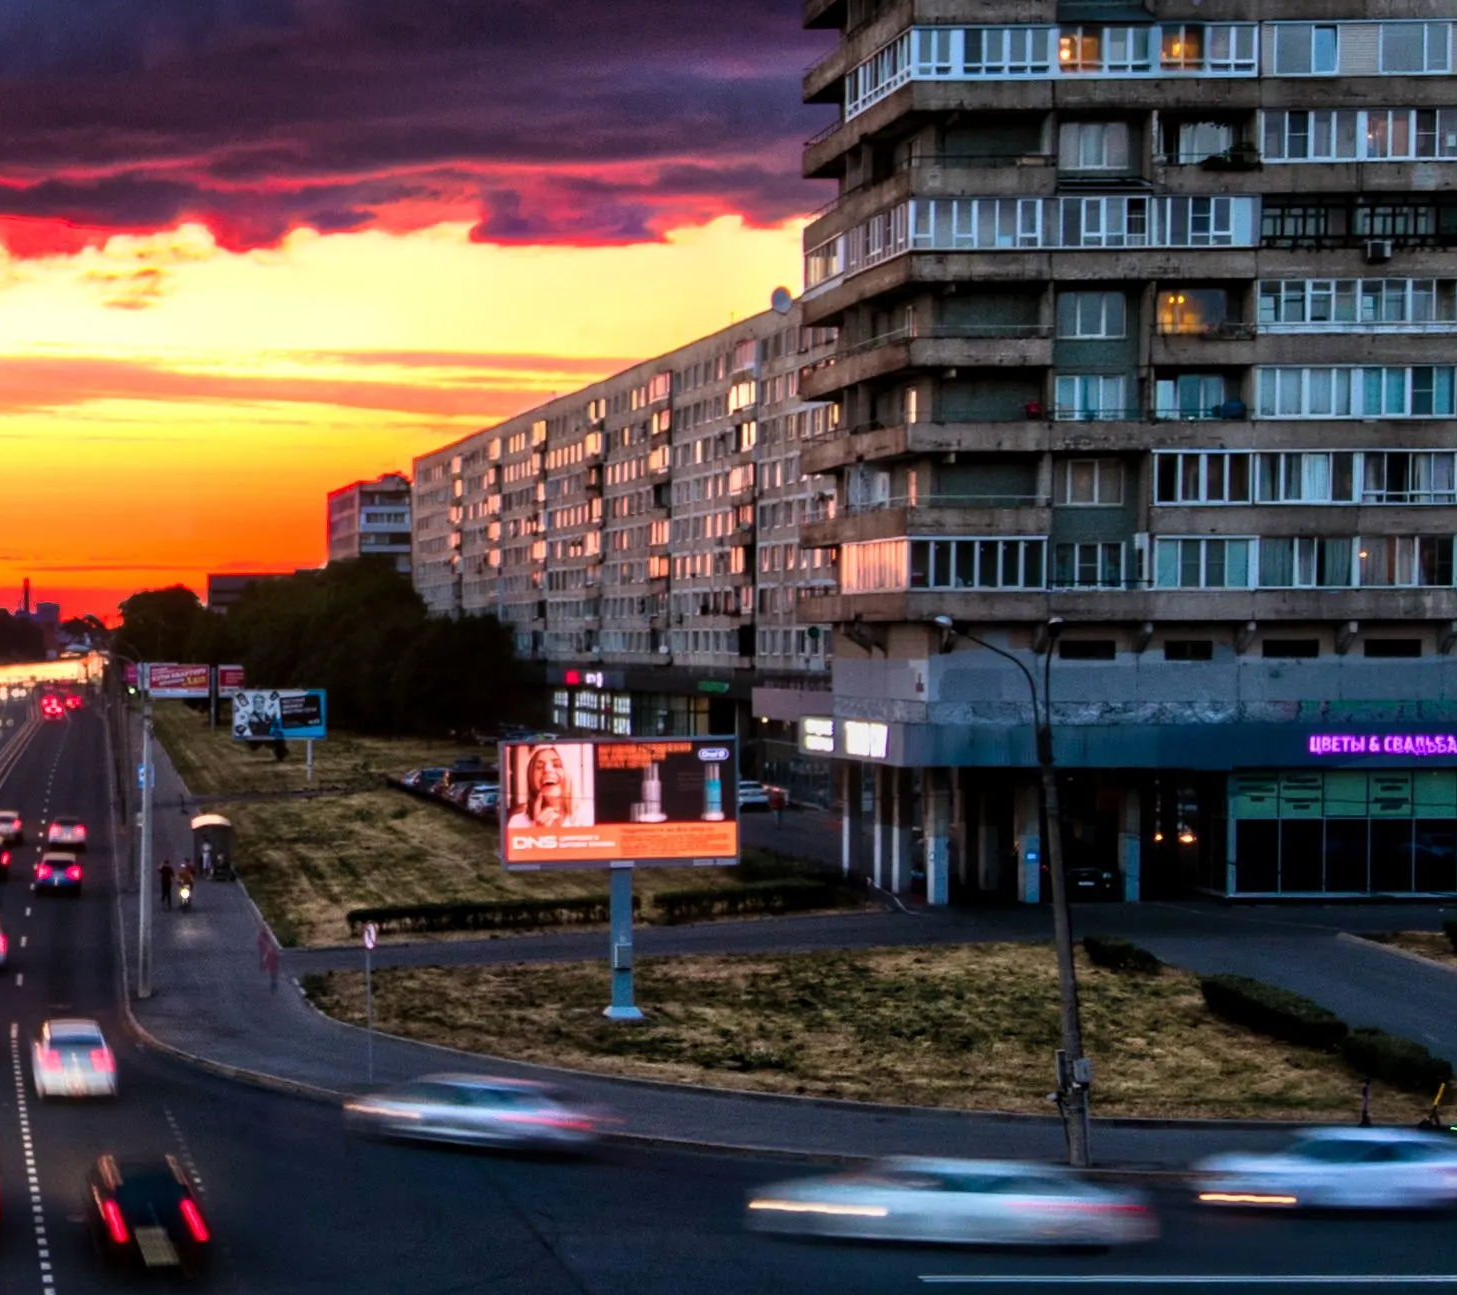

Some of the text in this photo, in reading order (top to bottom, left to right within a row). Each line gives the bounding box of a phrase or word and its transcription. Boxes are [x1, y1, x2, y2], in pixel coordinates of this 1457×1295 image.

[1309, 735, 1365, 754] ЦВЕТЫ
[1368, 735, 1380, 752] &
[512, 835, 557, 849] DNS
